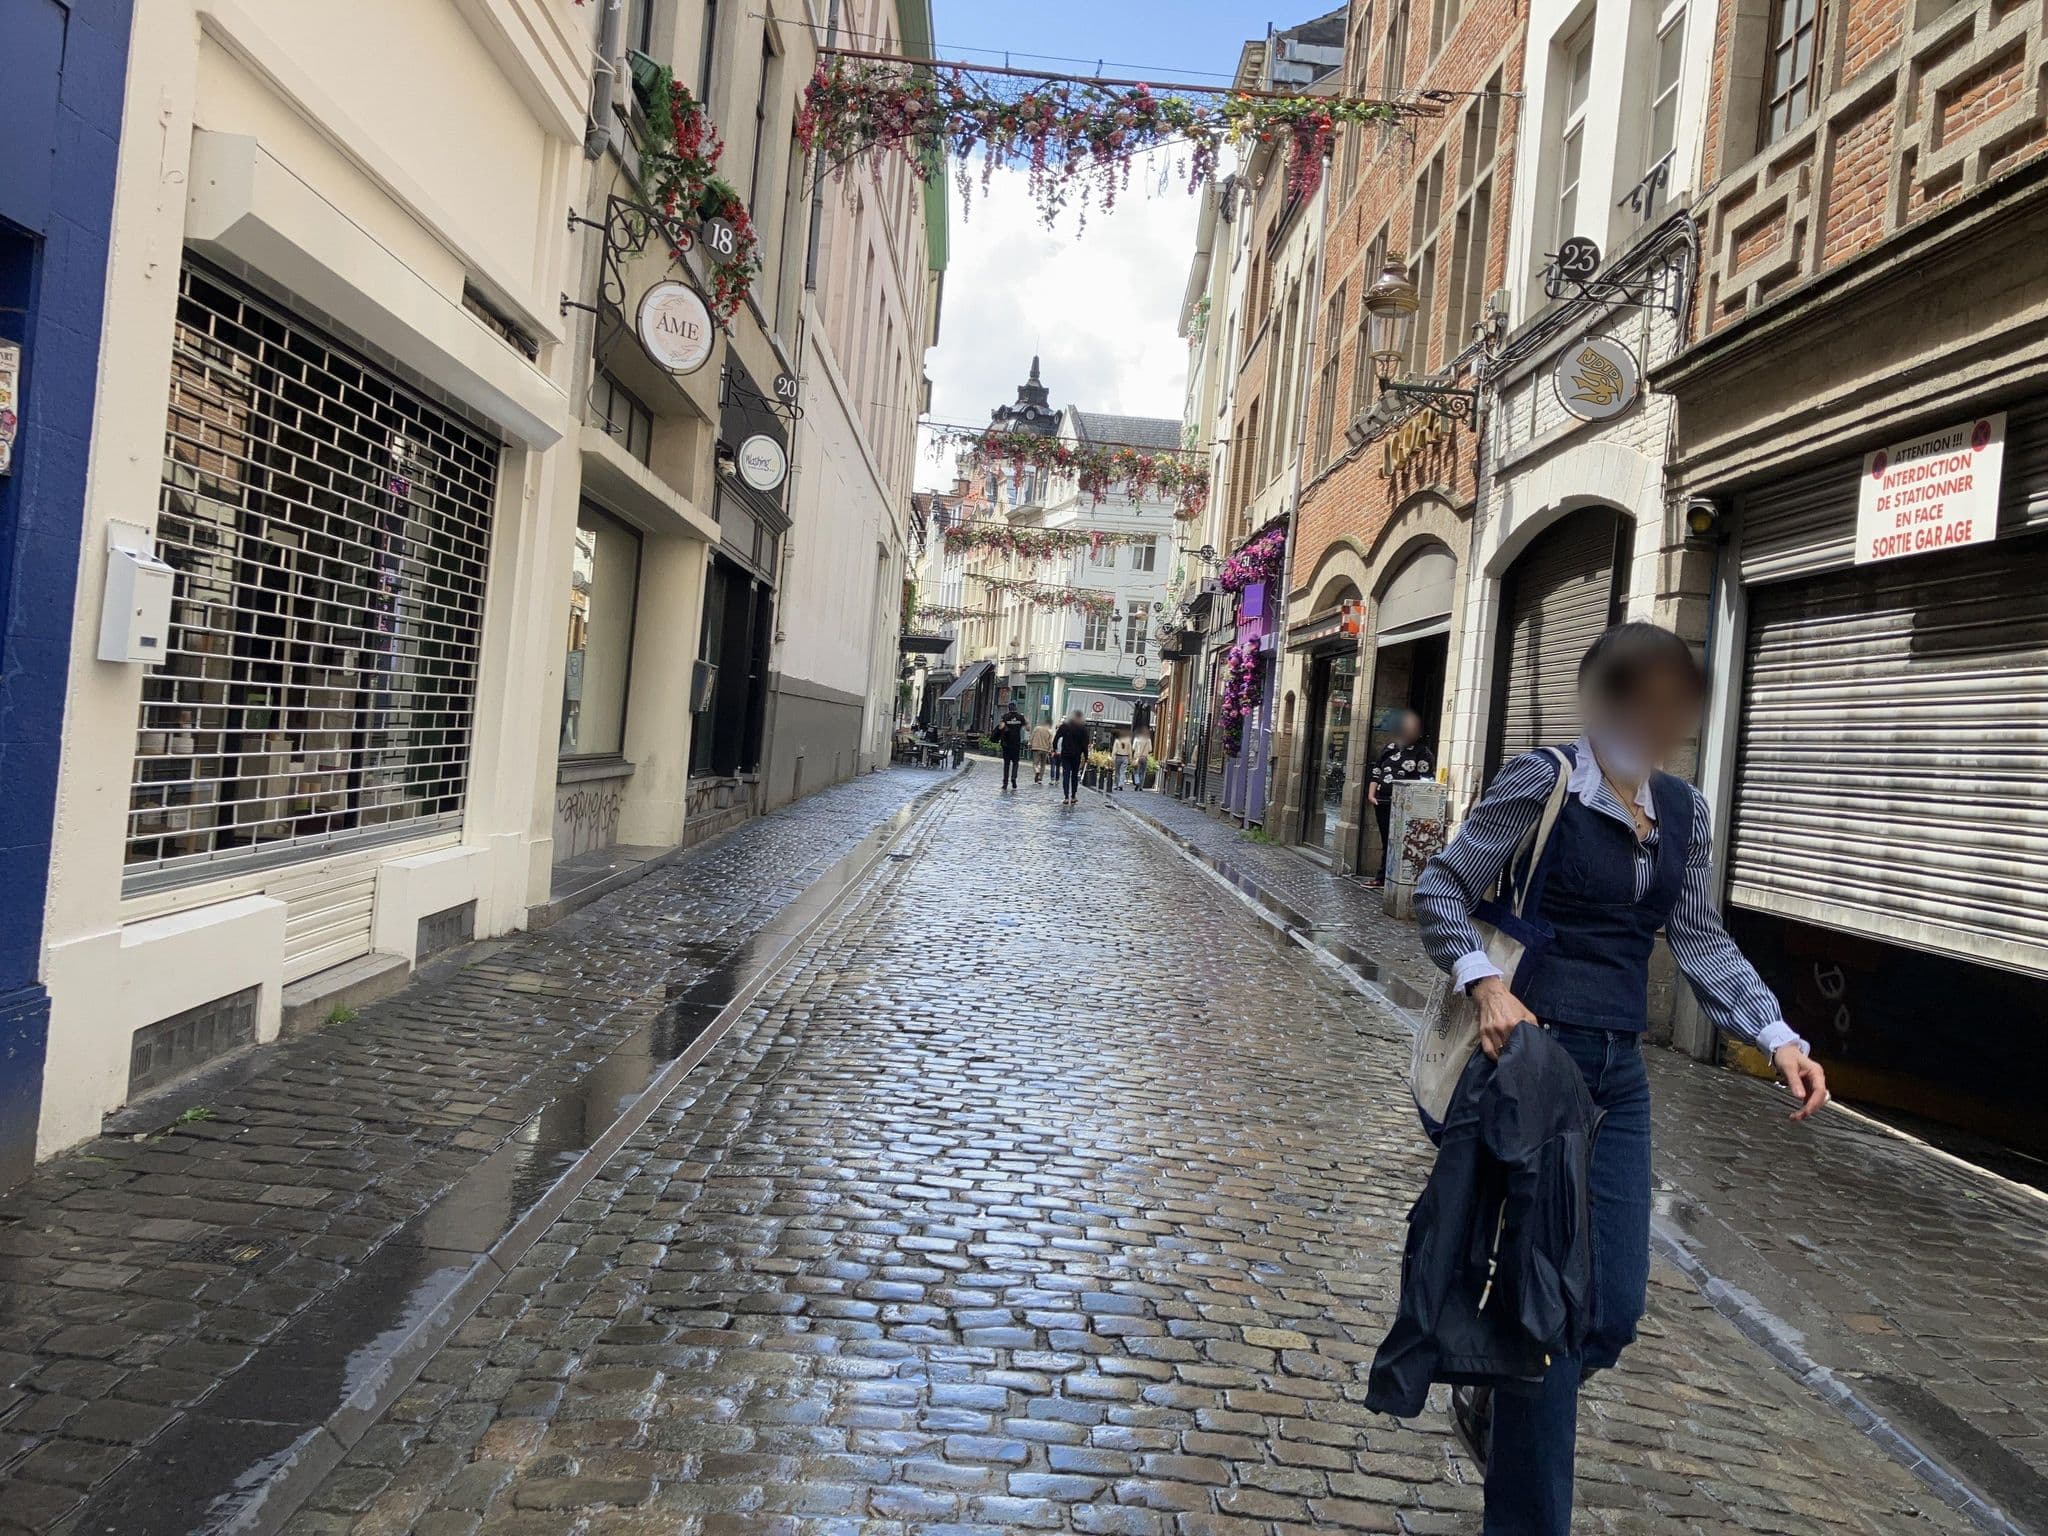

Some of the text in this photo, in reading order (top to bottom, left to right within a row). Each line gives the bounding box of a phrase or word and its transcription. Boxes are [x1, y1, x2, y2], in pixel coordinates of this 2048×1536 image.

[710, 222, 733, 255] 18
[1562, 244, 1597, 272] 23
[1583, 353, 1620, 380] JDID
[777, 377, 797, 398] 20
[1894, 432, 1963, 464] ATTENTION !!!
[1882, 452, 1972, 491] INTERDICTION
[1876, 474, 1973, 512] DE STATIONNER
[1895, 503, 1944, 528] EN FACE
[1872, 519, 1973, 559] SORTIE GARAGE
